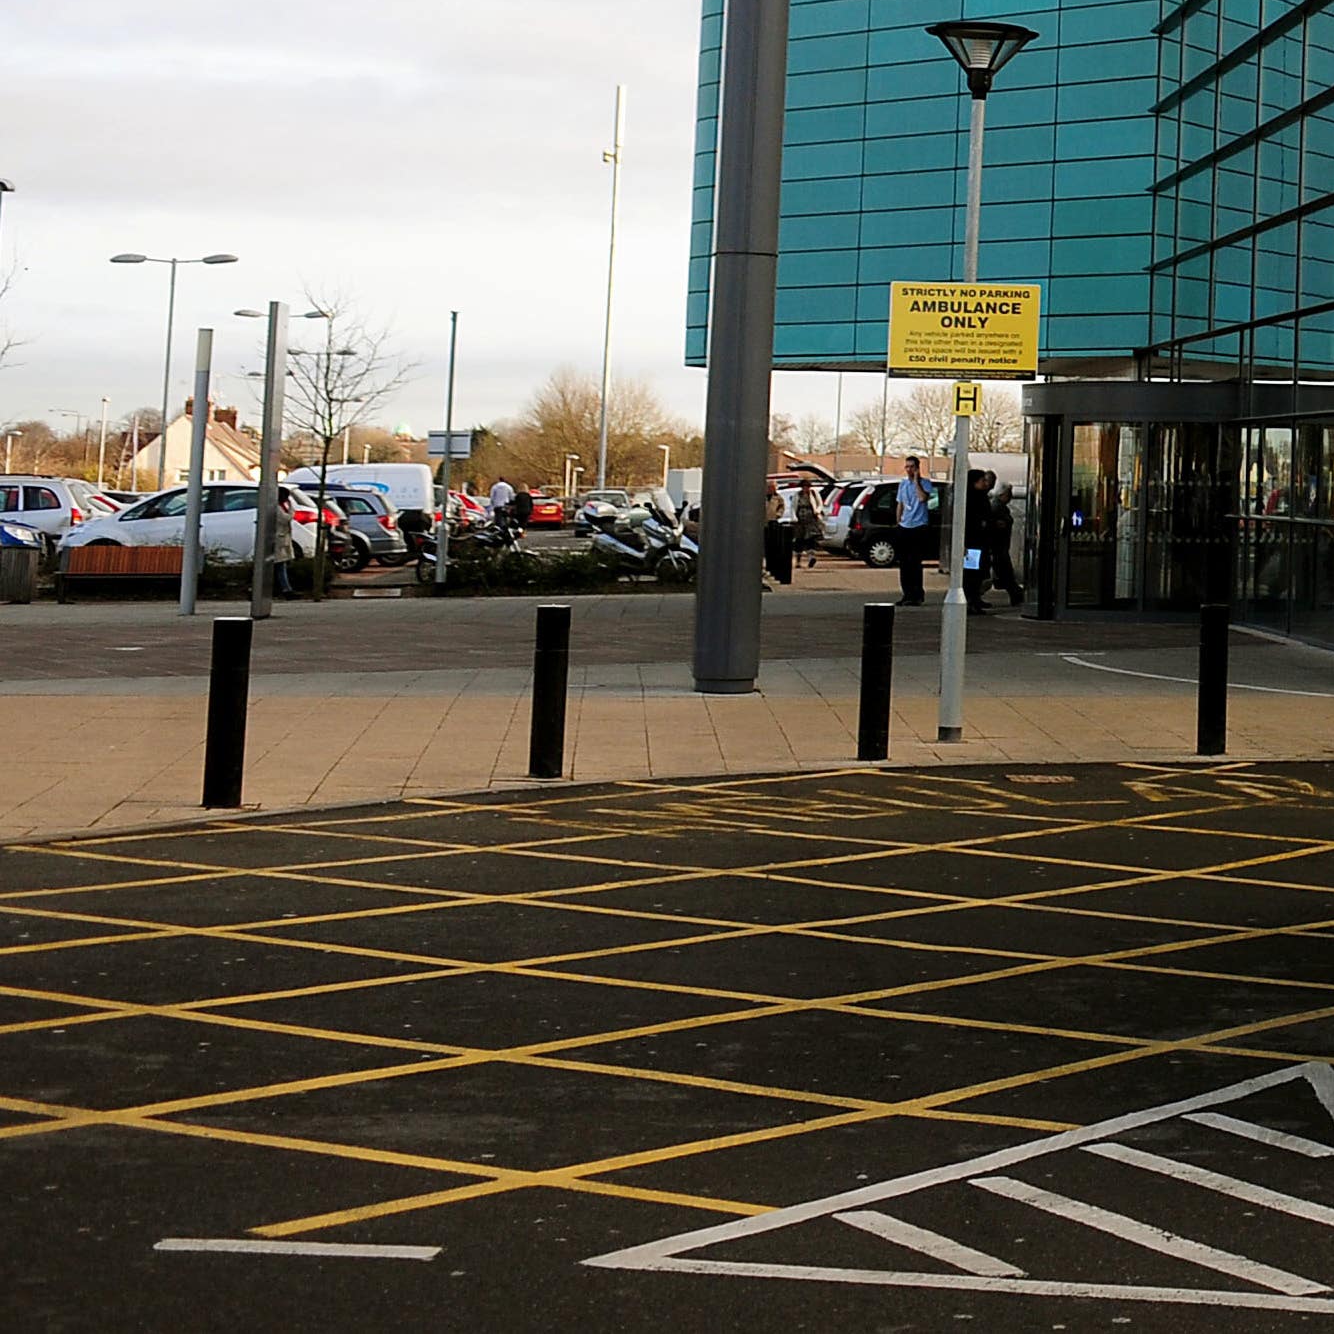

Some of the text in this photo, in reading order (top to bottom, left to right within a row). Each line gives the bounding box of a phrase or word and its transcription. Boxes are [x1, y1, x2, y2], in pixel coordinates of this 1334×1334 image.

[902, 288, 1030, 298] STRICTLY NO PARKING
[910, 301, 1021, 315] AMBULANCE
[941, 316, 989, 328] ONLY
[950, 356, 986, 365] penalty
[956, 386, 977, 412] H
